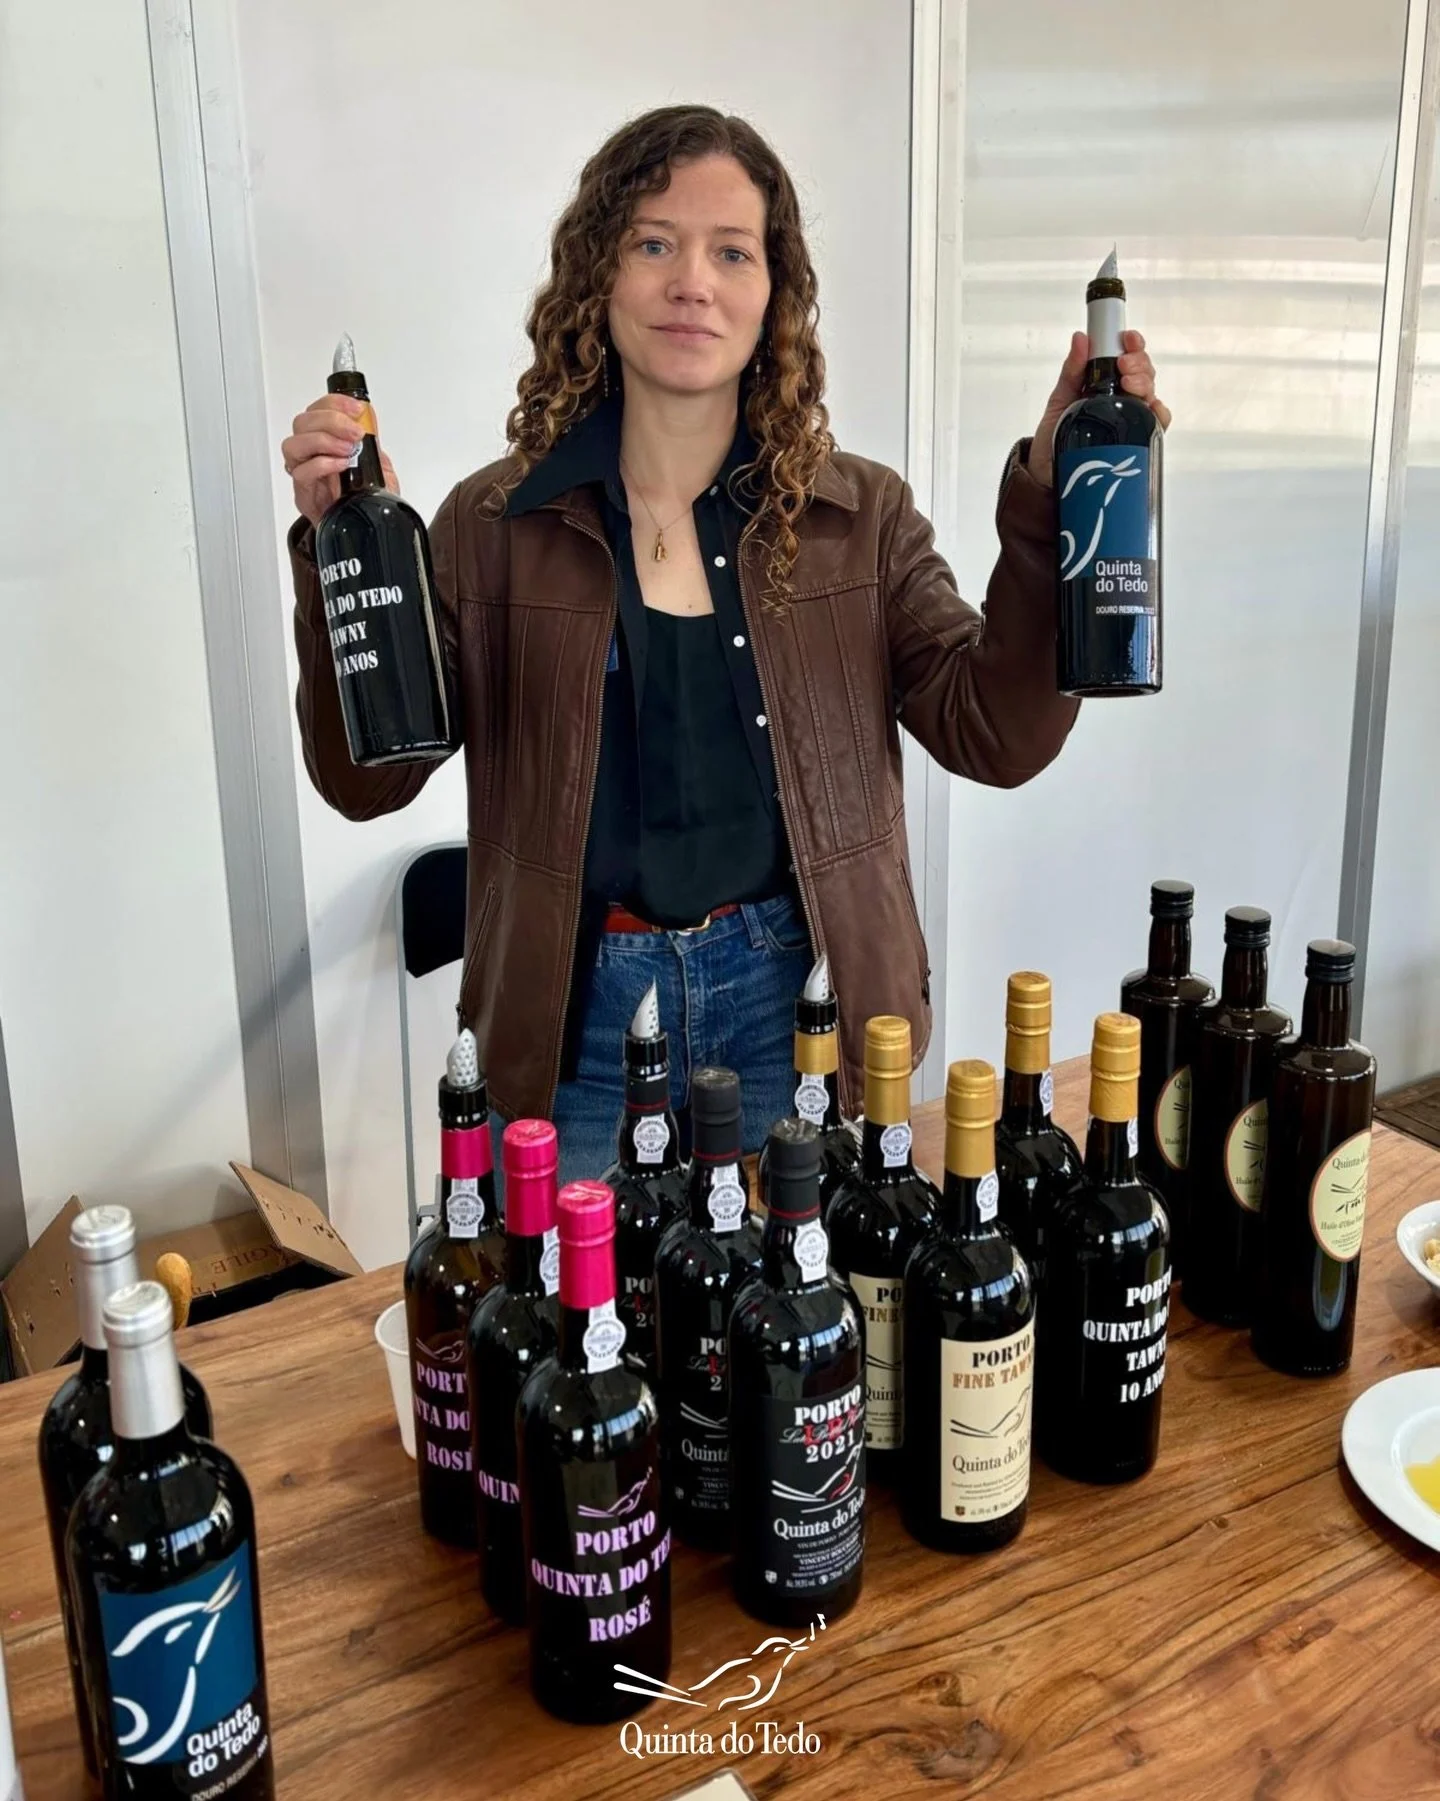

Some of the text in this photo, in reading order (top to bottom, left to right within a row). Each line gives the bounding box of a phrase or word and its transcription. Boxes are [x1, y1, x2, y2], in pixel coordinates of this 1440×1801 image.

[320, 557, 362, 585] ORTO
[1095, 560, 1142, 577] Quinta
[1095, 576, 1149, 593] do Tedo
[336, 593, 356, 614] DO
[358, 585, 404, 609] TEDO
[330, 621, 367, 649] AWNY
[343, 650, 379, 677] ANOS
[1332, 1157, 1361, 1171] Quinta
[1126, 1264, 1173, 1308] PORT
[1082, 1316, 1152, 1343] QUINTA
[972, 1333, 1031, 1368] PORTO
[1126, 1331, 1167, 1372] TAWN
[416, 1360, 467, 1394] PORT
[952, 1372, 995, 1389] FINE
[1120, 1382, 1140, 1403] 10
[794, 1384, 861, 1426] PORTO
[806, 1428, 854, 1463] 2021
[952, 1450, 1002, 1475] Quinta
[1004, 1445, 1018, 1464] do
[479, 1470, 520, 1504] QUIN
[576, 1510, 656, 1556] PORTO
[774, 1517, 830, 1541] Quinta
[832, 1503, 849, 1528] do
[531, 1557, 613, 1598] QUINTA
[619, 1558, 649, 1591] DO
[589, 1595, 651, 1642] ROSÉ
[186, 1702, 253, 1756] Quinta
[188, 1752, 219, 1778] do
[220, 1715, 260, 1761] Tedo
